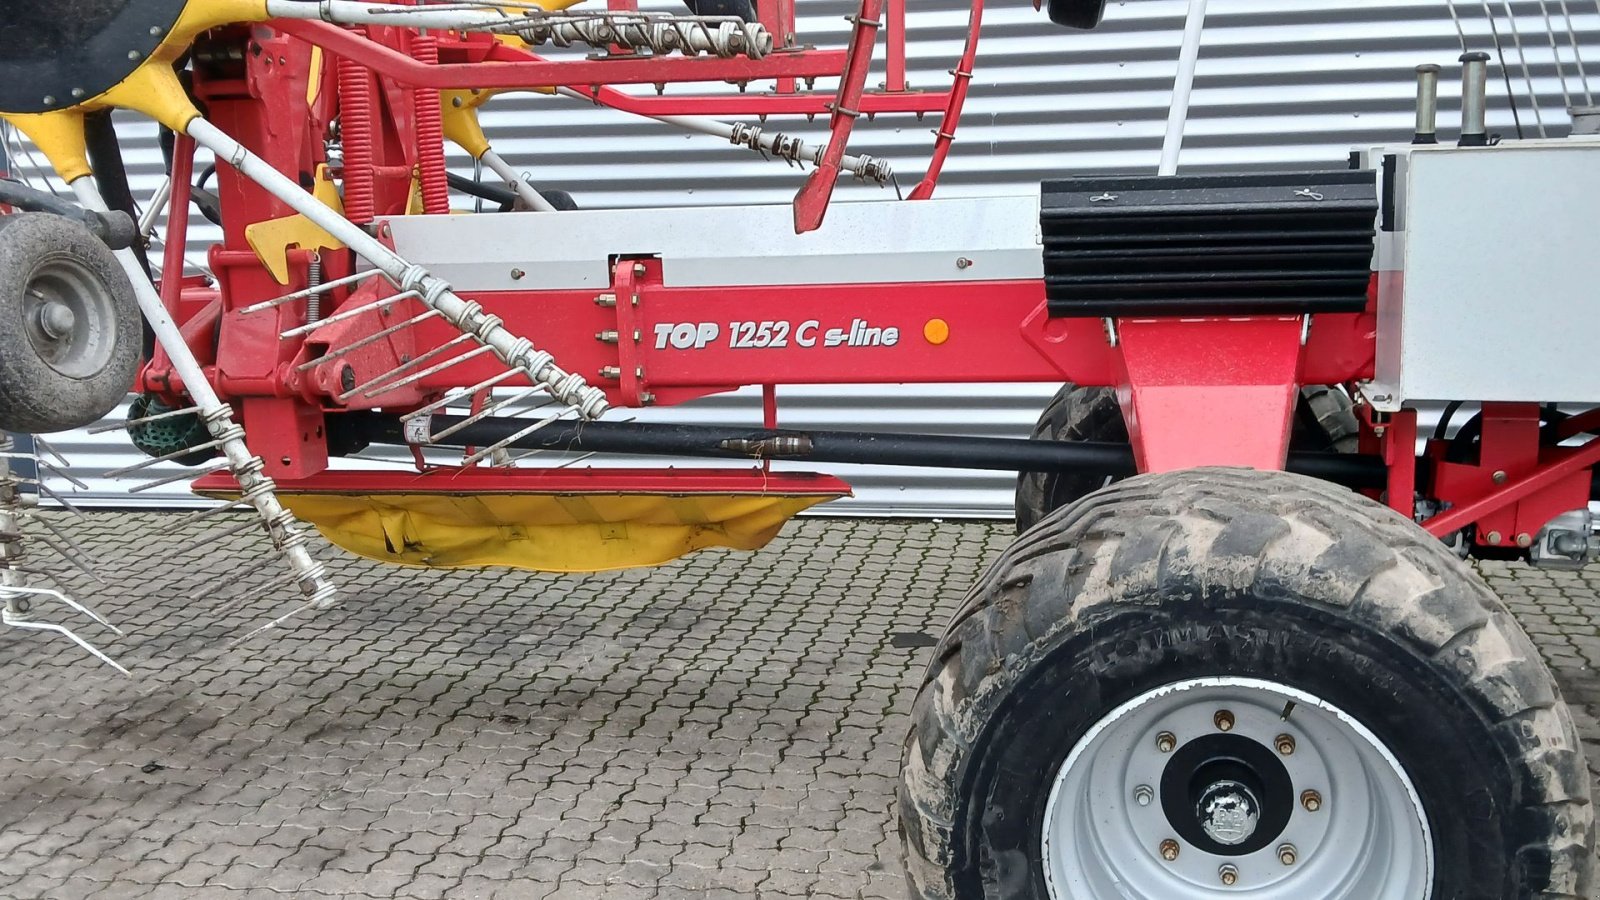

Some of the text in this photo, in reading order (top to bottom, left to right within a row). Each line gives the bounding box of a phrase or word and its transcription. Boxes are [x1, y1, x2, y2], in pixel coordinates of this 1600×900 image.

[654, 318, 899, 349] TOP 1252 C s-line
